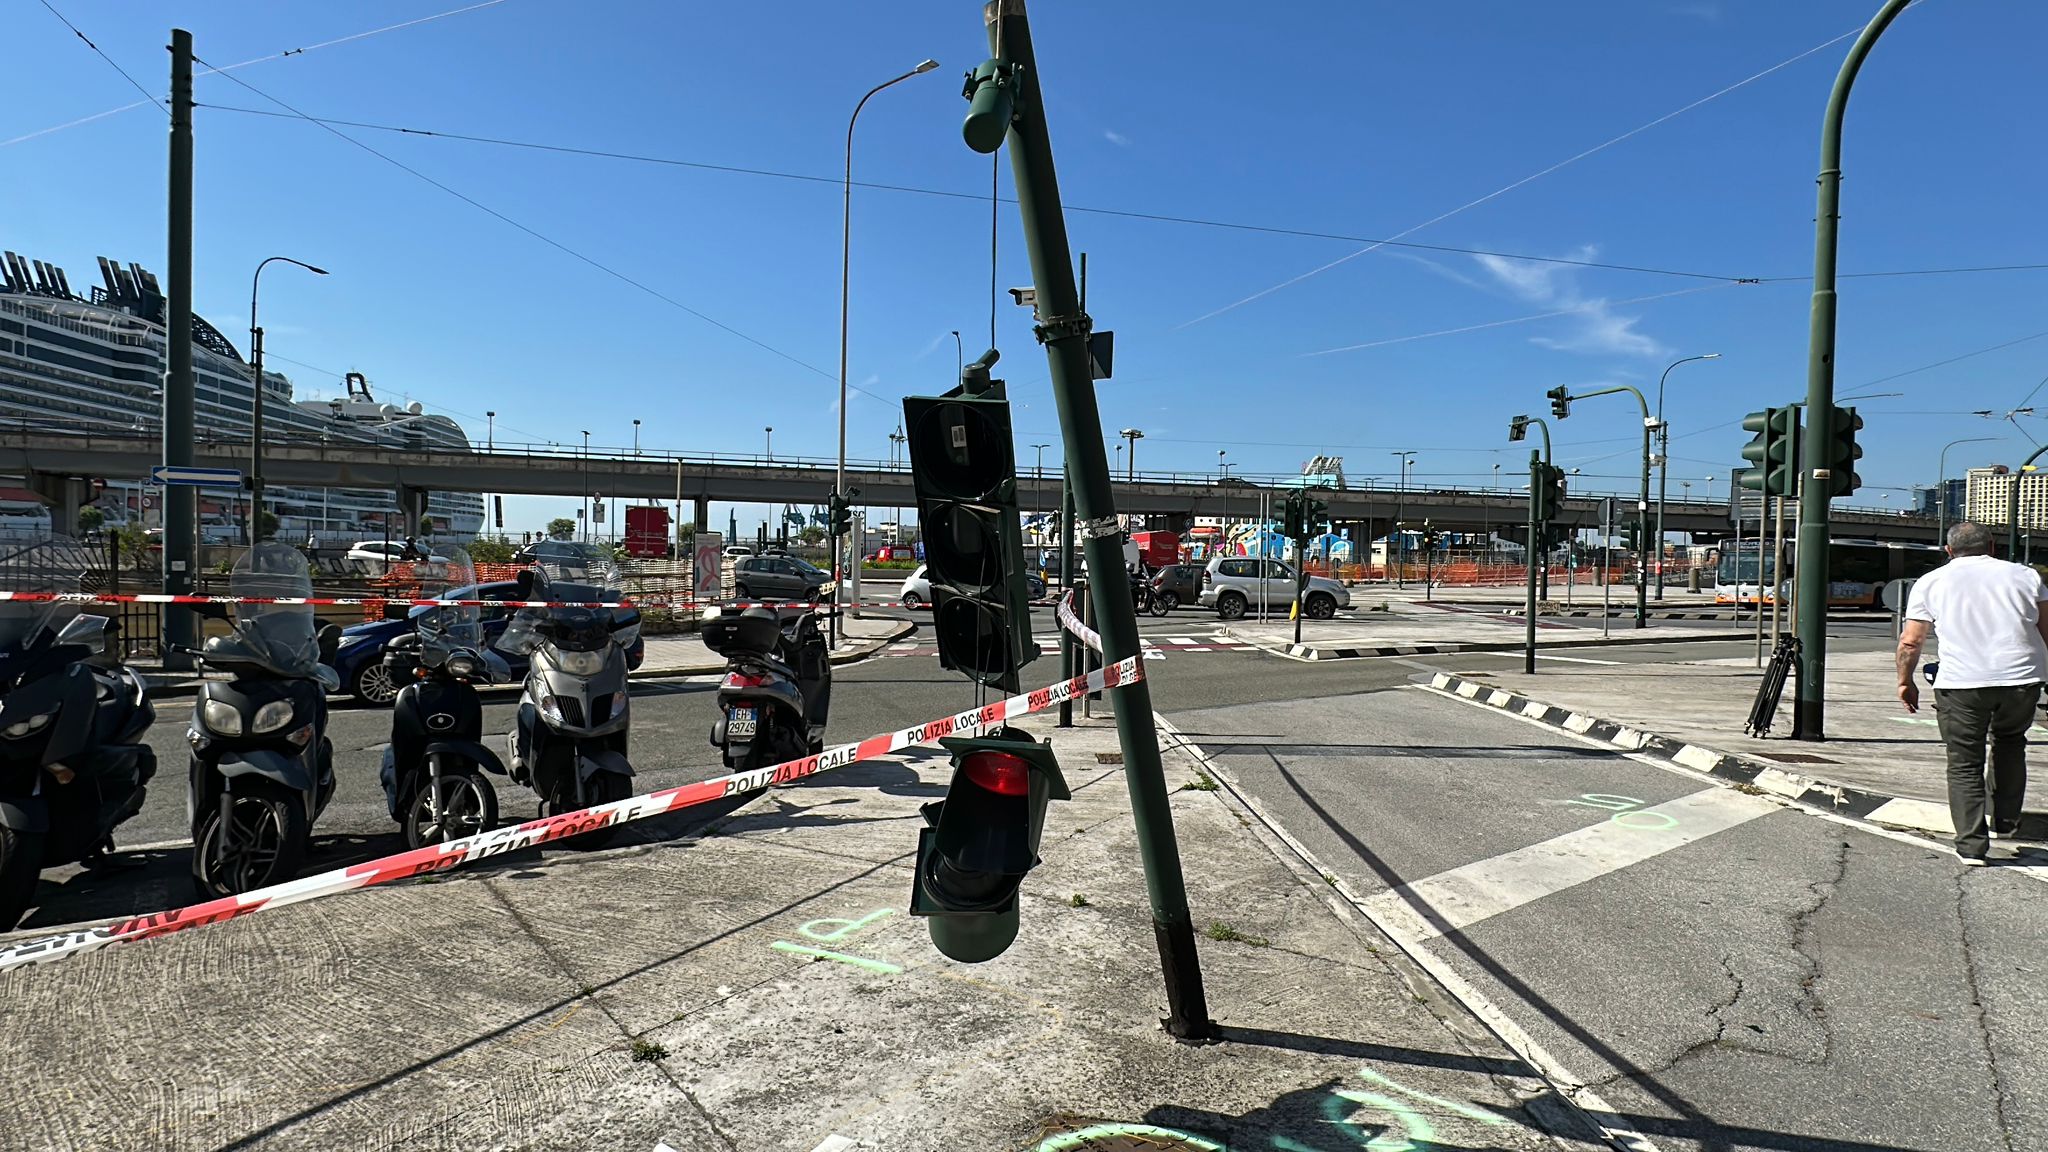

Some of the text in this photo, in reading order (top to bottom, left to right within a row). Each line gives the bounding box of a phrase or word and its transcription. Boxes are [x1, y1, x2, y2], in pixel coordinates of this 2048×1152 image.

[1027, 687, 1060, 708] POLIZIA
[729, 722, 755, 734] 29749
[907, 708, 995, 744] POLIZIA LOCALE
[724, 747, 857, 796] POLIZIA LOCALE
